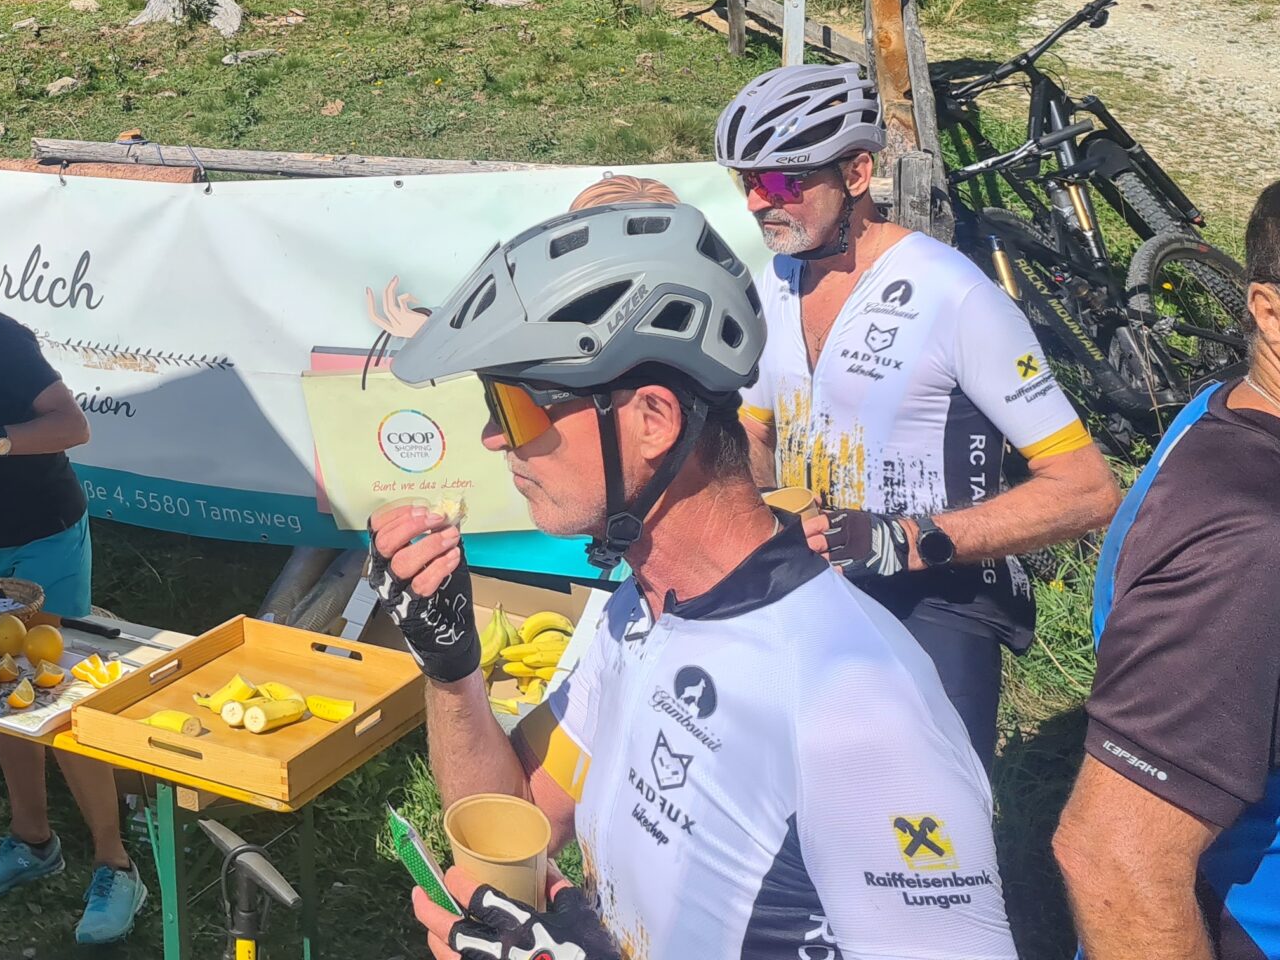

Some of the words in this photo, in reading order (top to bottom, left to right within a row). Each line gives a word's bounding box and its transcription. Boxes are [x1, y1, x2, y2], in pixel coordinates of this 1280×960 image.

[606, 283, 649, 334] LAZER
[1015, 257, 1052, 296] ROCKY
[1047, 298, 1105, 362] MOUNTAIN
[386, 431, 435, 445] COOP
[394, 444, 433, 452] SHOPPING
[400, 451, 430, 459] CENTER
[969, 434, 986, 466] RC
[372, 480, 397, 492] Bunt
[401, 481, 416, 491] wie
[419, 479, 437, 490] das
[135, 489, 191, 517] 5580
[195, 499, 303, 533] Tamsweg
[632, 802, 670, 847] bikeshop
[863, 871, 994, 889] Raiffeisenbank
[902, 891, 972, 909] Lungau
